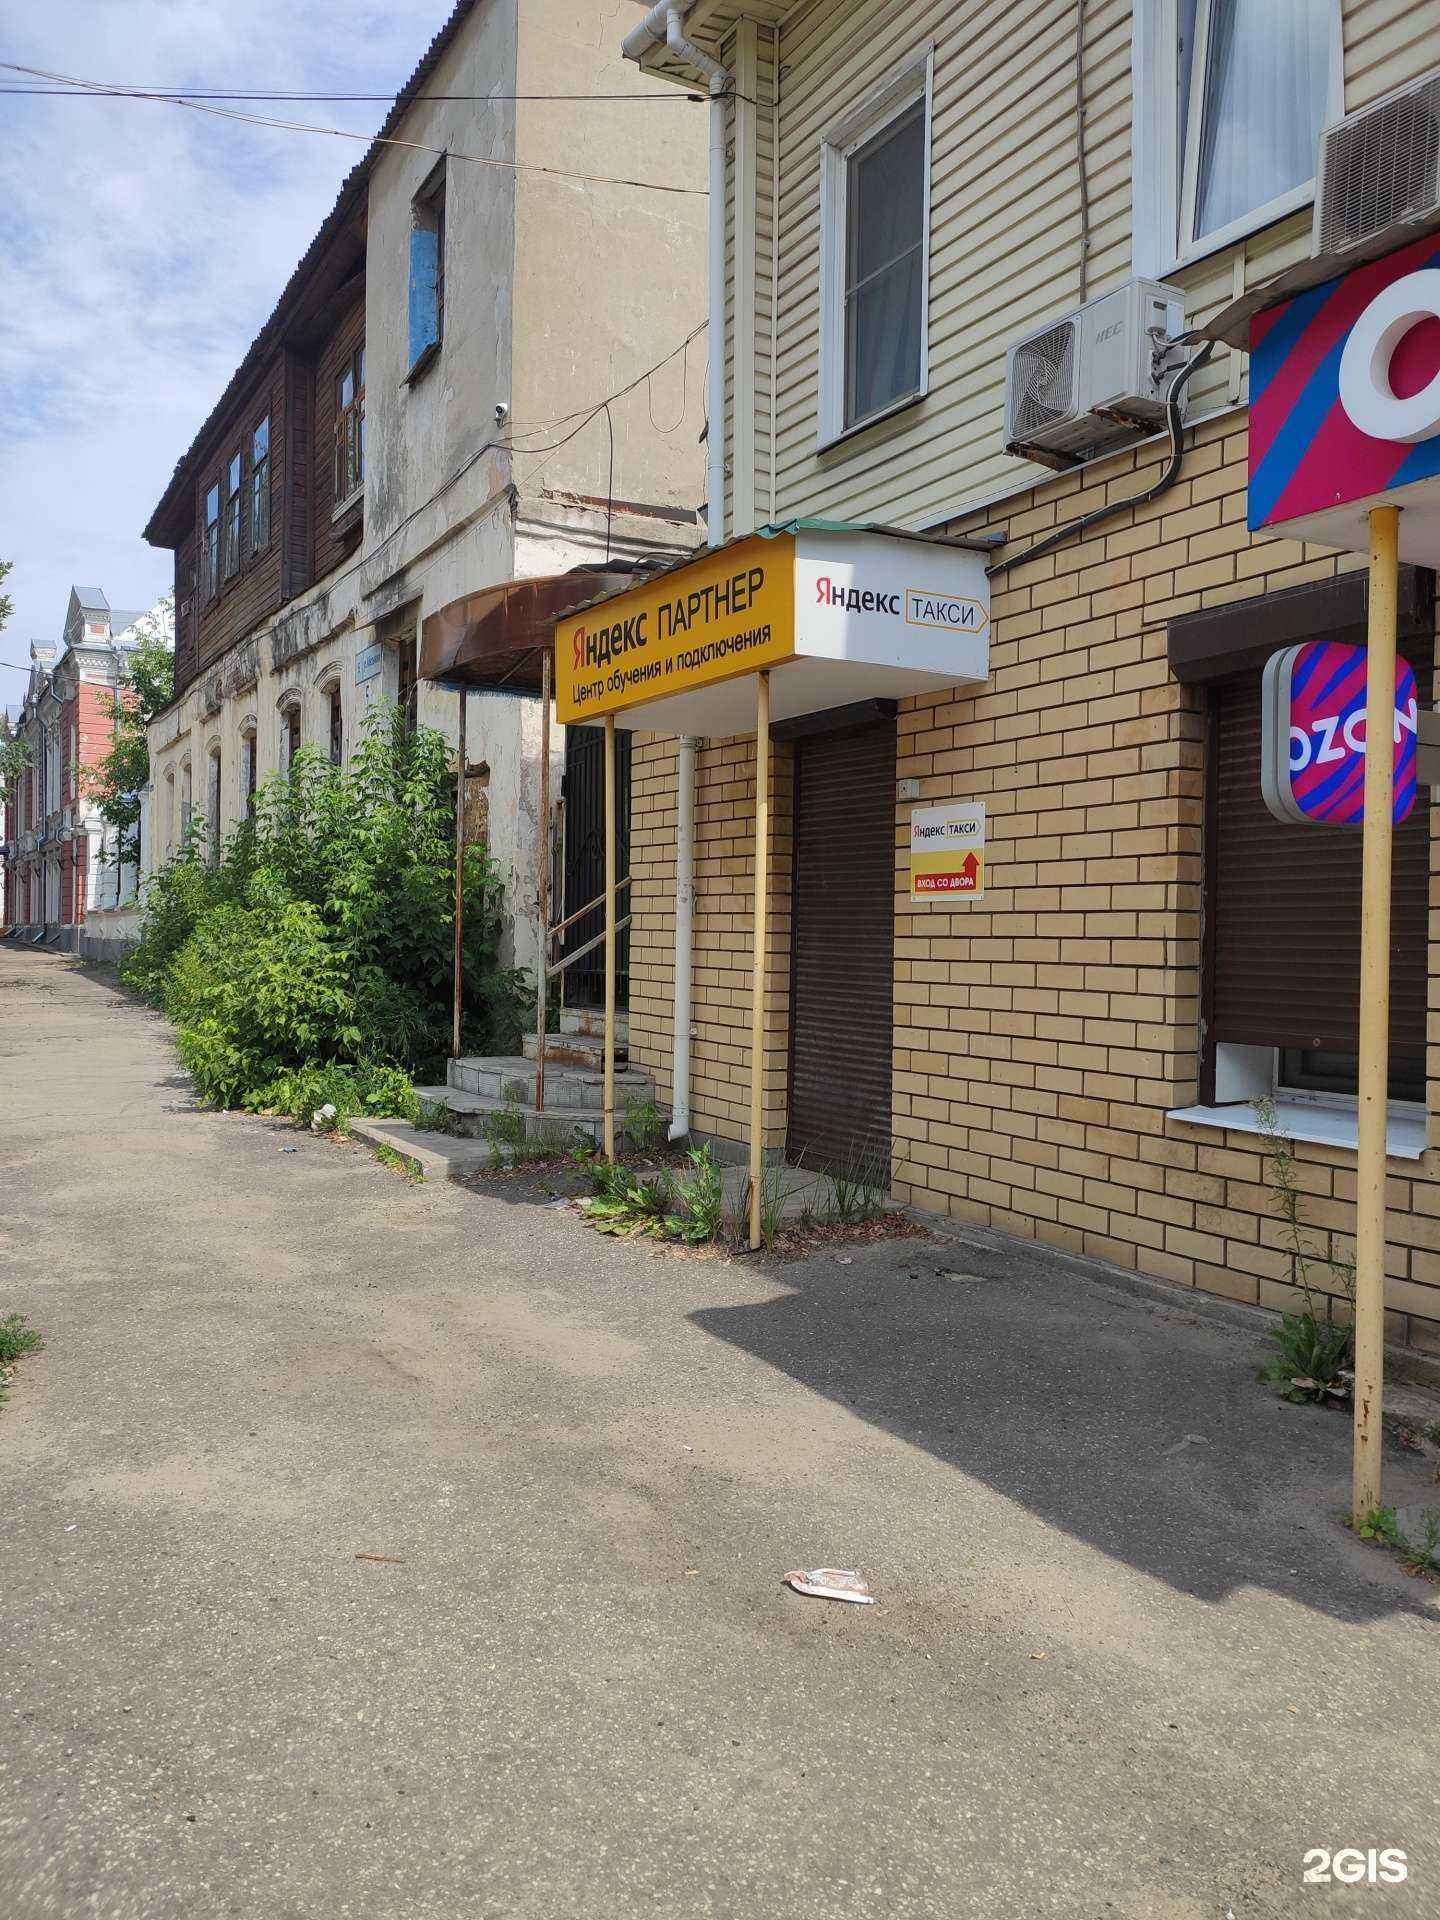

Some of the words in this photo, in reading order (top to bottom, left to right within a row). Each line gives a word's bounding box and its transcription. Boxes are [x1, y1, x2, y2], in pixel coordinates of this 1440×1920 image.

[573, 612, 648, 672] Яндекс
[658, 567, 765, 640] ПАРТНЕР
[816, 576, 900, 615] Яндекс
[912, 598, 974, 626] ТАКСИ
[572, 678, 604, 706] Центр
[607, 659, 662, 694] обучения
[666, 658, 673, 675] и
[677, 624, 772, 672] подключения
[913, 823, 945, 839] Яндекс
[949, 822, 976, 835] ТАКСИ
[917, 879, 935, 888] ВХОД
[937, 878, 948, 887] СО
[950, 877, 974, 888] ДВОРА
